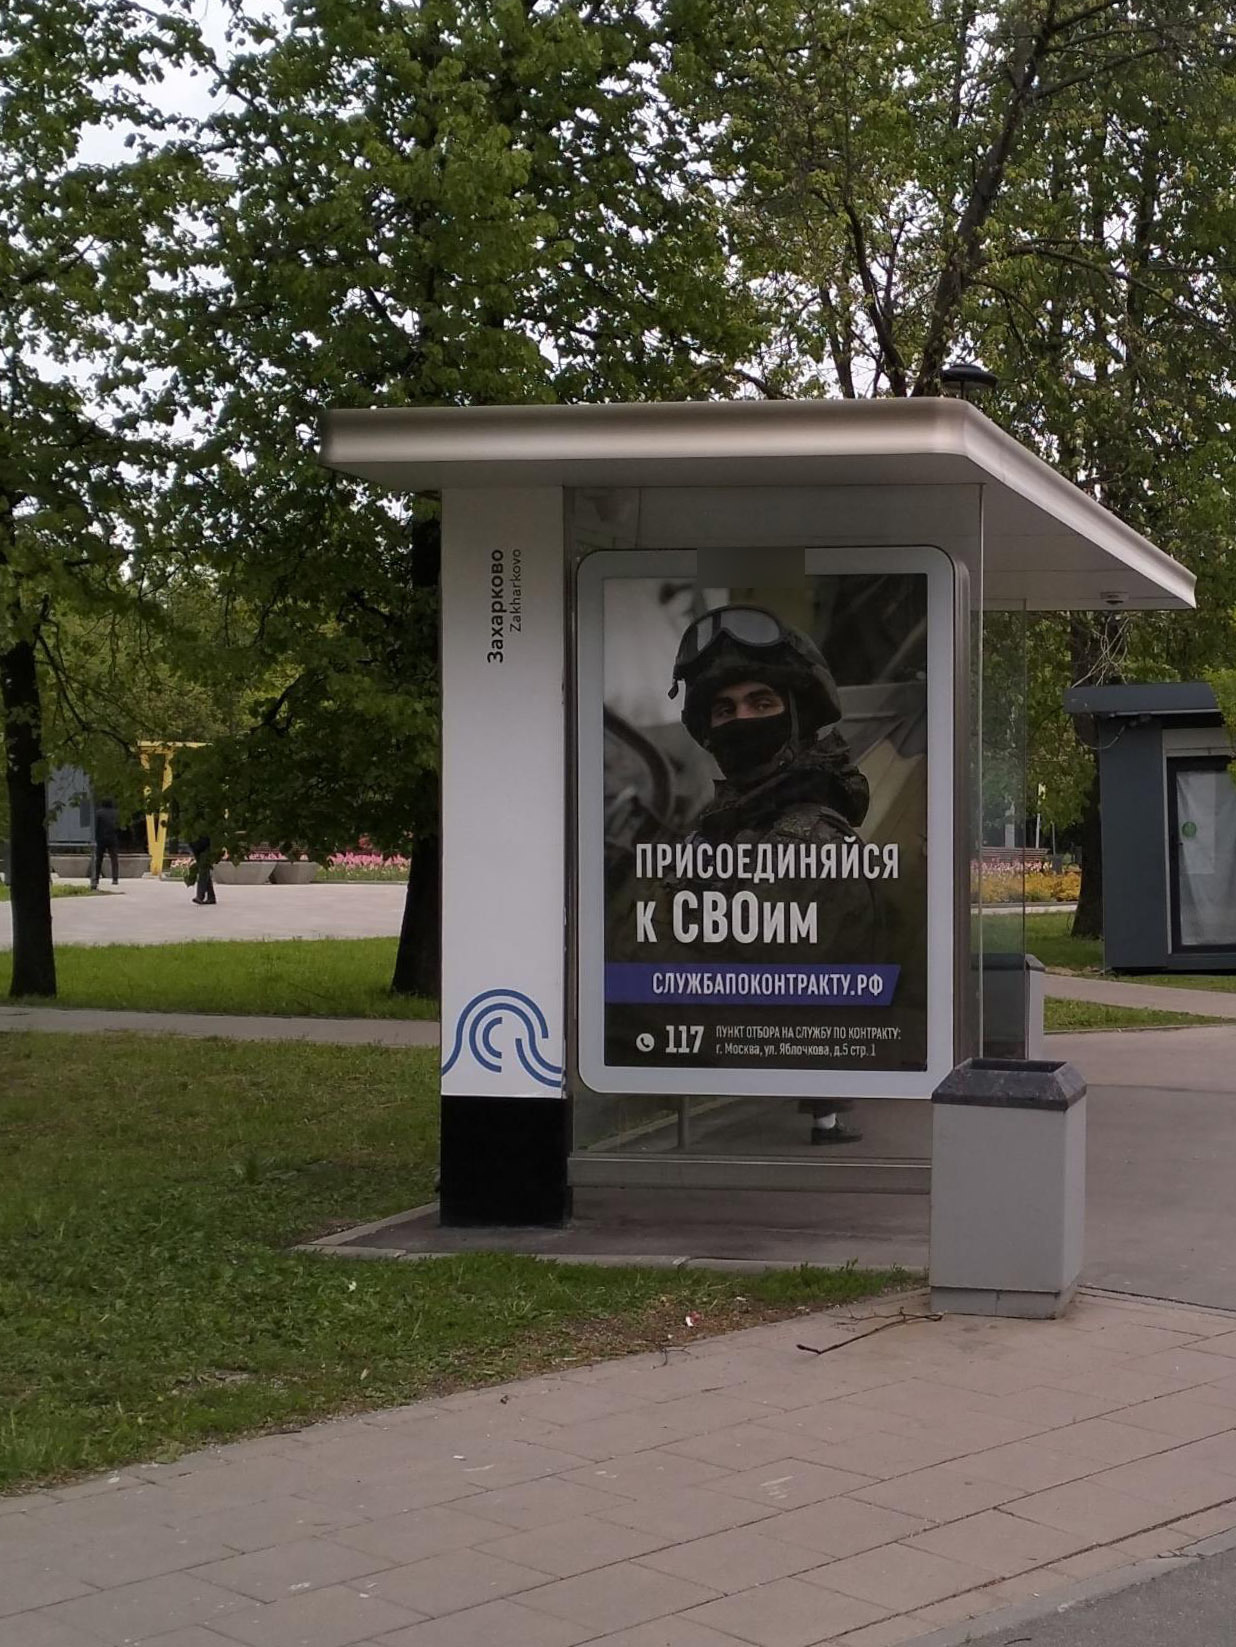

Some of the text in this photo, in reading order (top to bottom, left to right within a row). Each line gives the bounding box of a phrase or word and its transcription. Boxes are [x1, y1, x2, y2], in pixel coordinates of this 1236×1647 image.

[509, 549, 521, 632] Zakharkovo
[487, 549, 507, 663] Захарково
[636, 836, 899, 884] ПРИСОЕДИНЯЙСЯ
[652, 972, 883, 997] СЛУЖБАПОКОНТРАКТУ.РФ
[665, 1025, 705, 1053] 117
[716, 1025, 901, 1039] ПУНКТ ОТБОРА НА СЛУЖБУ ПО КОНТРАКТУ:
[716, 1044, 723, 1054] г.
[725, 1042, 763, 1056] Москва,
[764, 1044, 777, 1057] ул.
[779, 1042, 832, 1057] Яблочкова,
[850, 1045, 869, 1058] стр.
